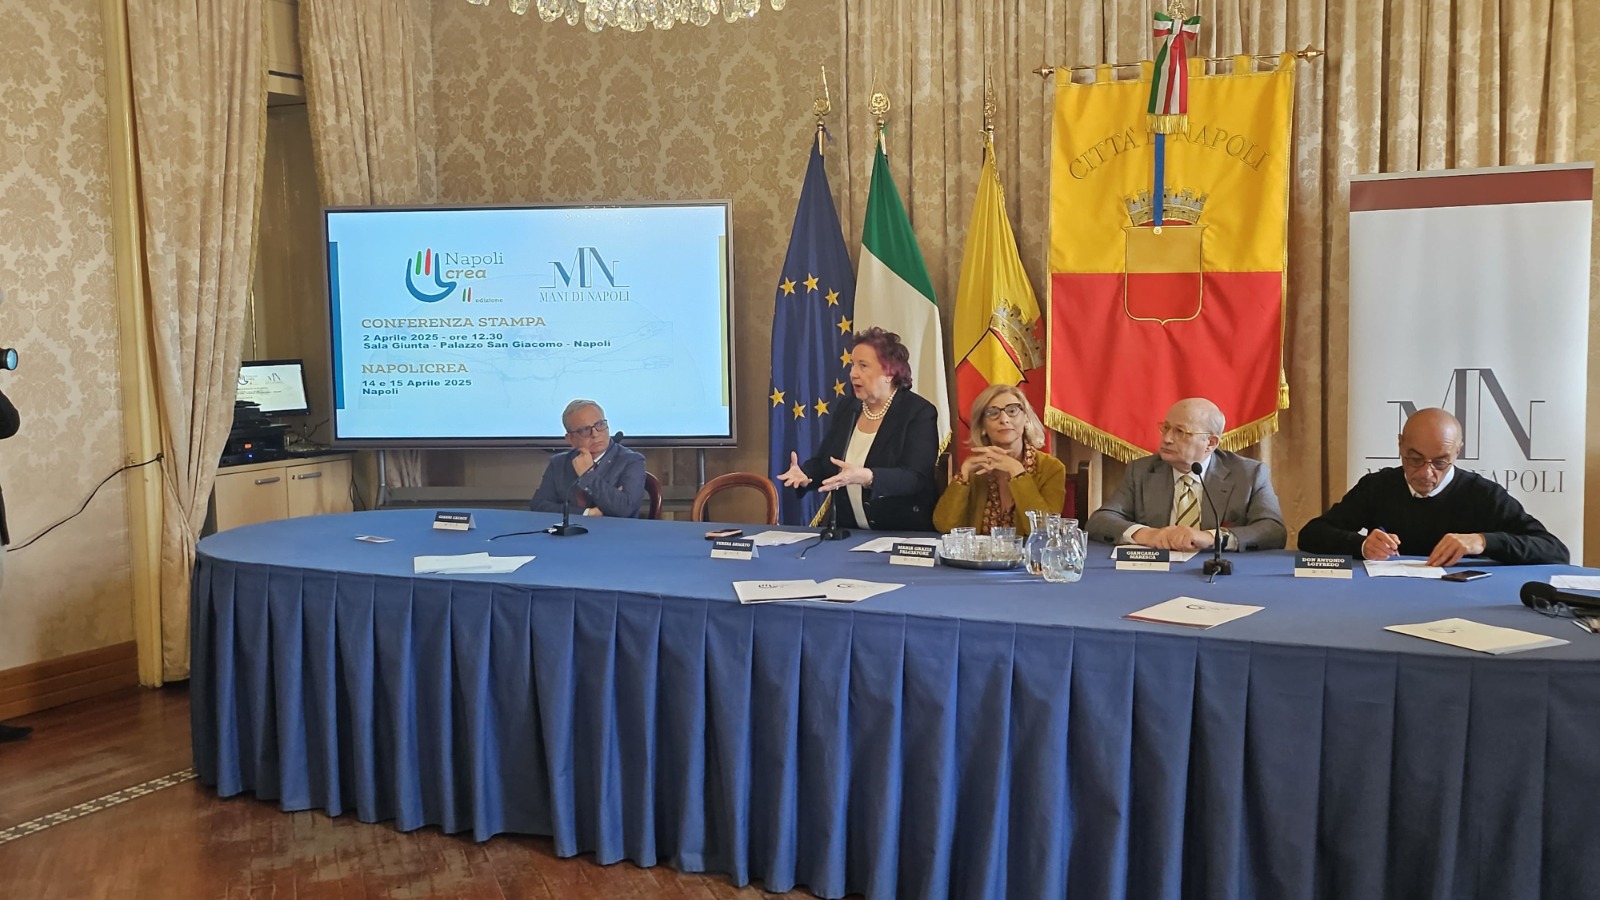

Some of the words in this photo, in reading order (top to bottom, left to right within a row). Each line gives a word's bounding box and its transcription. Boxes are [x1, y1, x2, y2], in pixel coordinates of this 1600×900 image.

[445, 252, 504, 267] Napoli
[445, 268, 487, 279] crea
[539, 292, 569, 302] MANI
[572, 291, 585, 301] DI
[588, 290, 630, 301] NAPOLI
[361, 318, 474, 329] CONFERENZA
[478, 316, 546, 327] STAMPA
[363, 334, 370, 342] 2
[374, 334, 407, 342] Aprile
[411, 333, 438, 341] 2025
[472, 332, 503, 341] 12.30
[363, 342, 388, 350] Sala
[392, 342, 429, 350] Giunta
[440, 341, 483, 349] Palazzo
[512, 340, 563, 348] Giacomo
[574, 340, 611, 348] Napoli
[361, 363, 469, 374] NAPOLICREA
[407, 379, 440, 388] Aprile
[362, 388, 398, 396] Napoli
[1472, 469, 1565, 493] POLI
